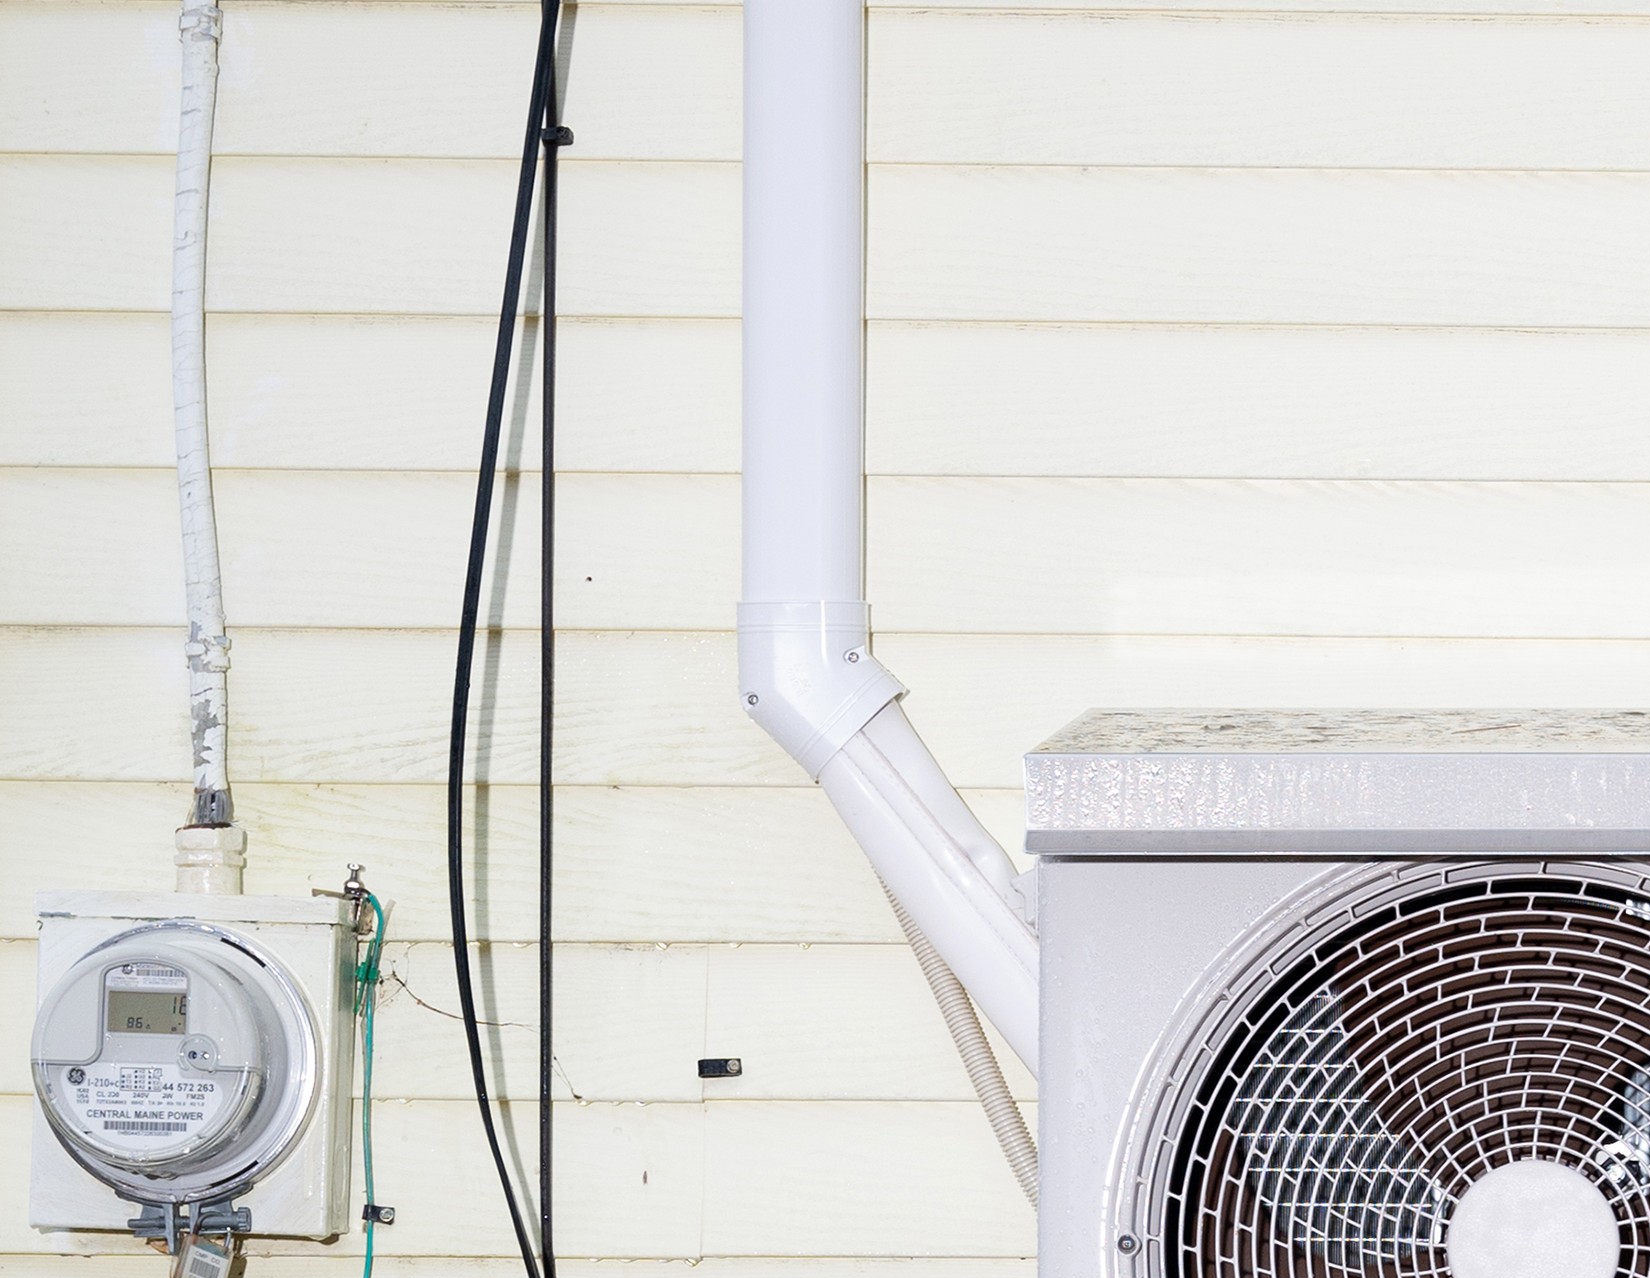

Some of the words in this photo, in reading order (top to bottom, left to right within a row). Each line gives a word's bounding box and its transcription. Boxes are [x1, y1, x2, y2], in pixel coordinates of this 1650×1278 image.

[177, 1082, 194, 1092] 572
[197, 1083, 214, 1092] 263
[86, 1109, 130, 1118] CENTRAL
[134, 1110, 165, 1120] MAINE
[168, 1111, 203, 1121] POWER
